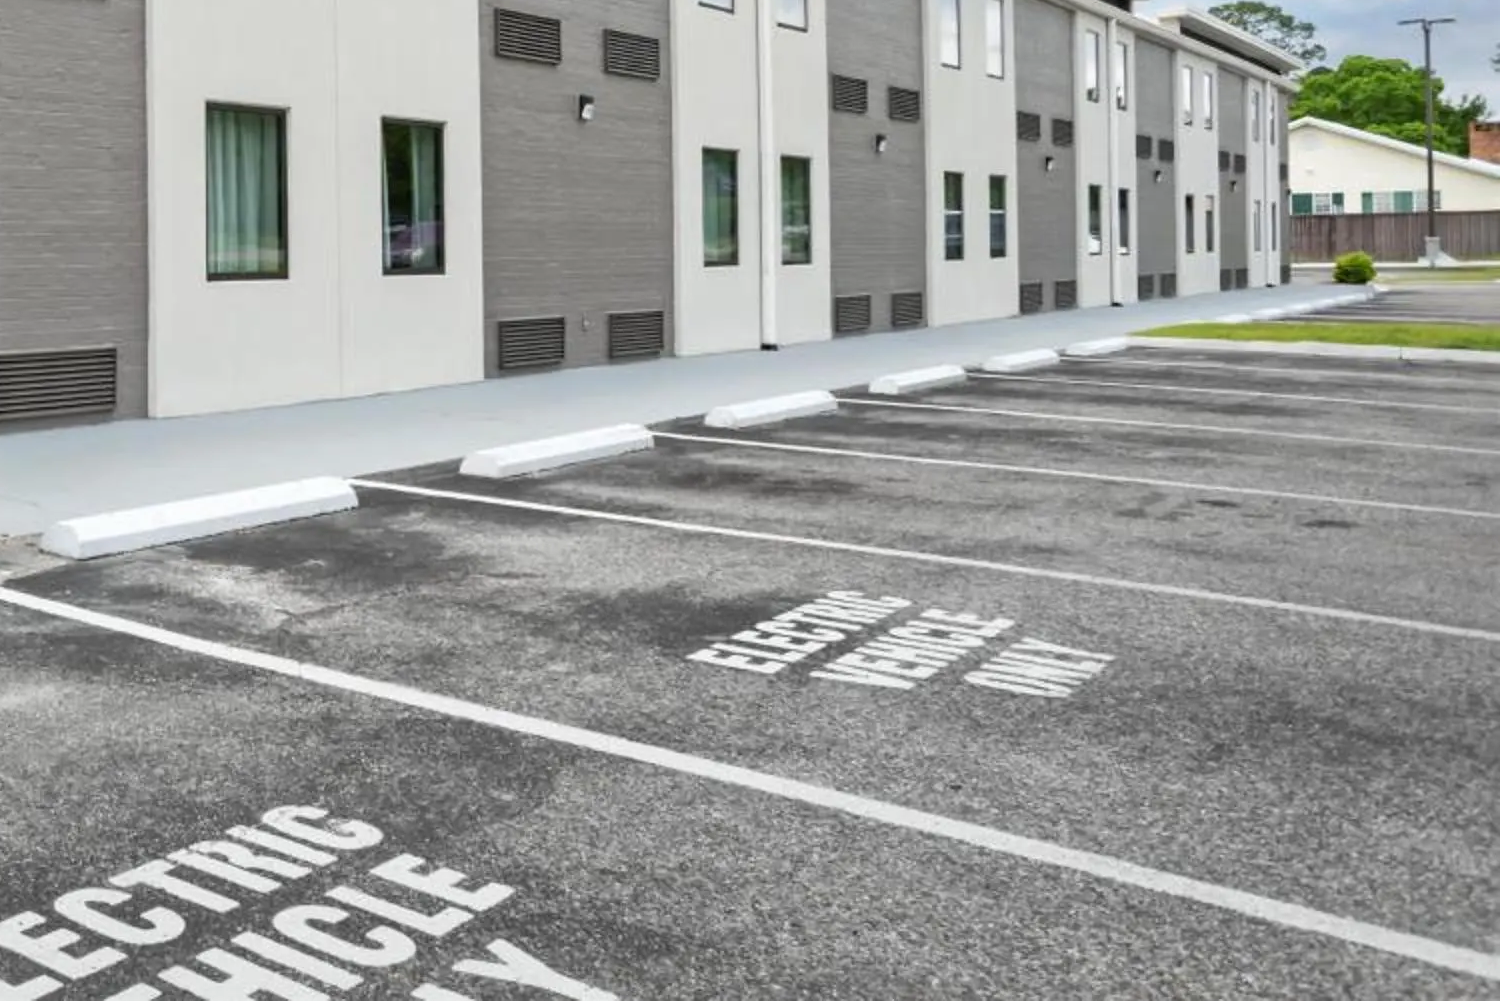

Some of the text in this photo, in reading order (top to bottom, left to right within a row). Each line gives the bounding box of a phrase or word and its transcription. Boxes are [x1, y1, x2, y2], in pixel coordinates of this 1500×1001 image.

[686, 590, 911, 675] ELECTRIC
[809, 608, 1016, 689] VEHICLE
[964, 637, 1115, 698] ONLY
[103, 853, 515, 1001] HICLE
